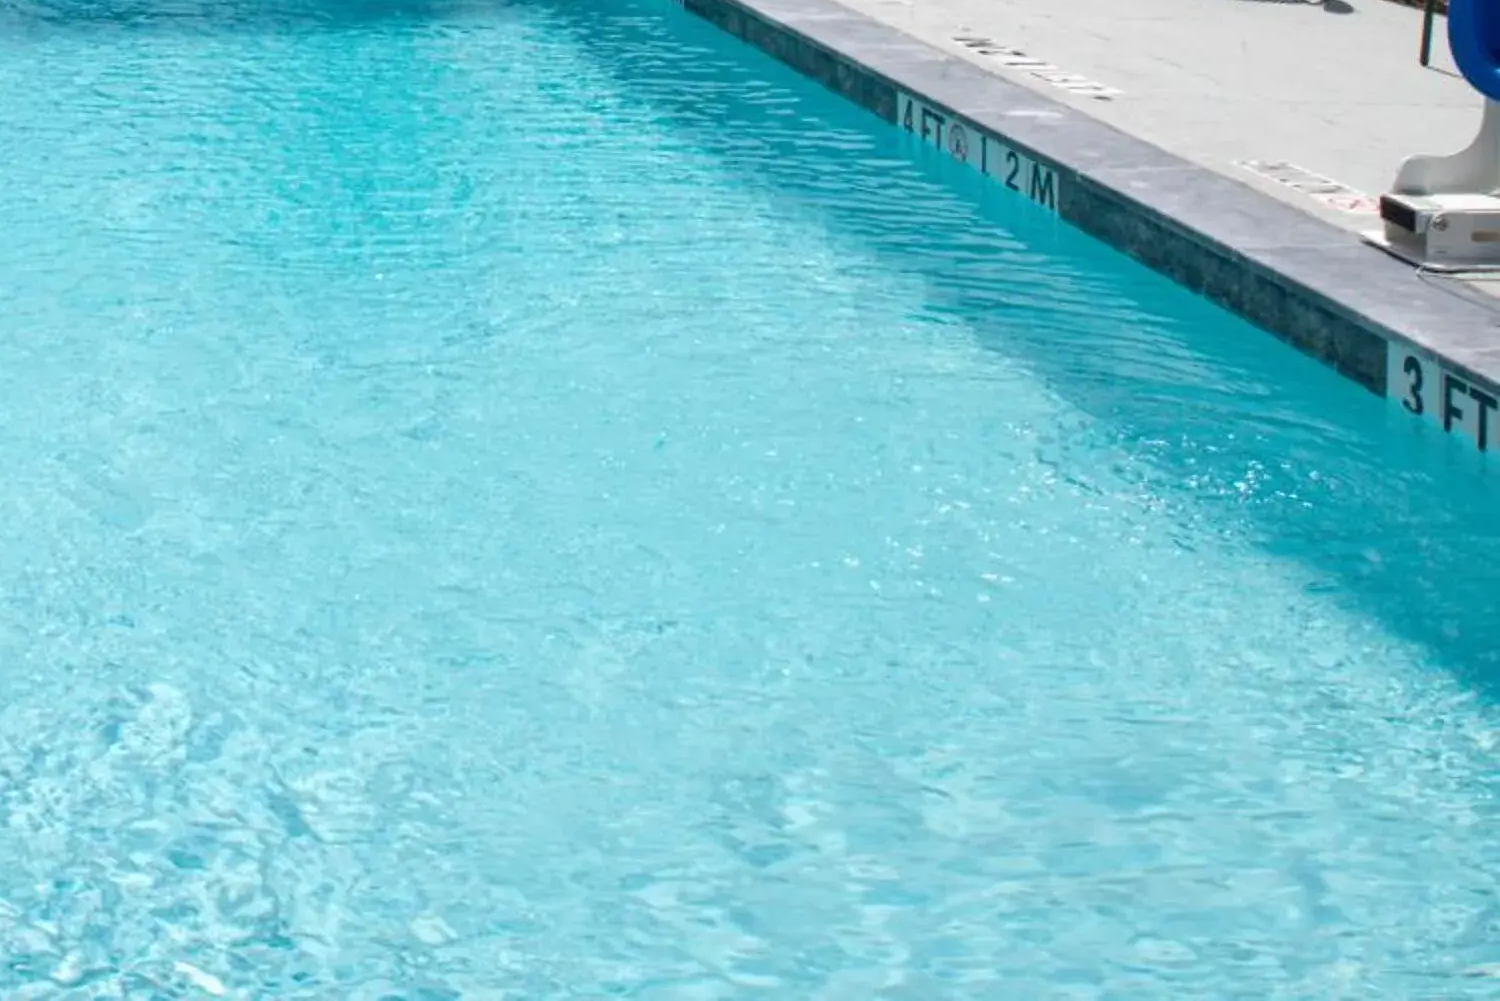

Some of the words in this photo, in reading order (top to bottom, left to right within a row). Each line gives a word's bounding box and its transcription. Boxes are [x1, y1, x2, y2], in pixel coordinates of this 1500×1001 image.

[920, 107, 946, 151] FT
[1030, 161, 1056, 211] M
[1402, 355, 1424, 416] 3
[1443, 373, 1499, 454] FT
